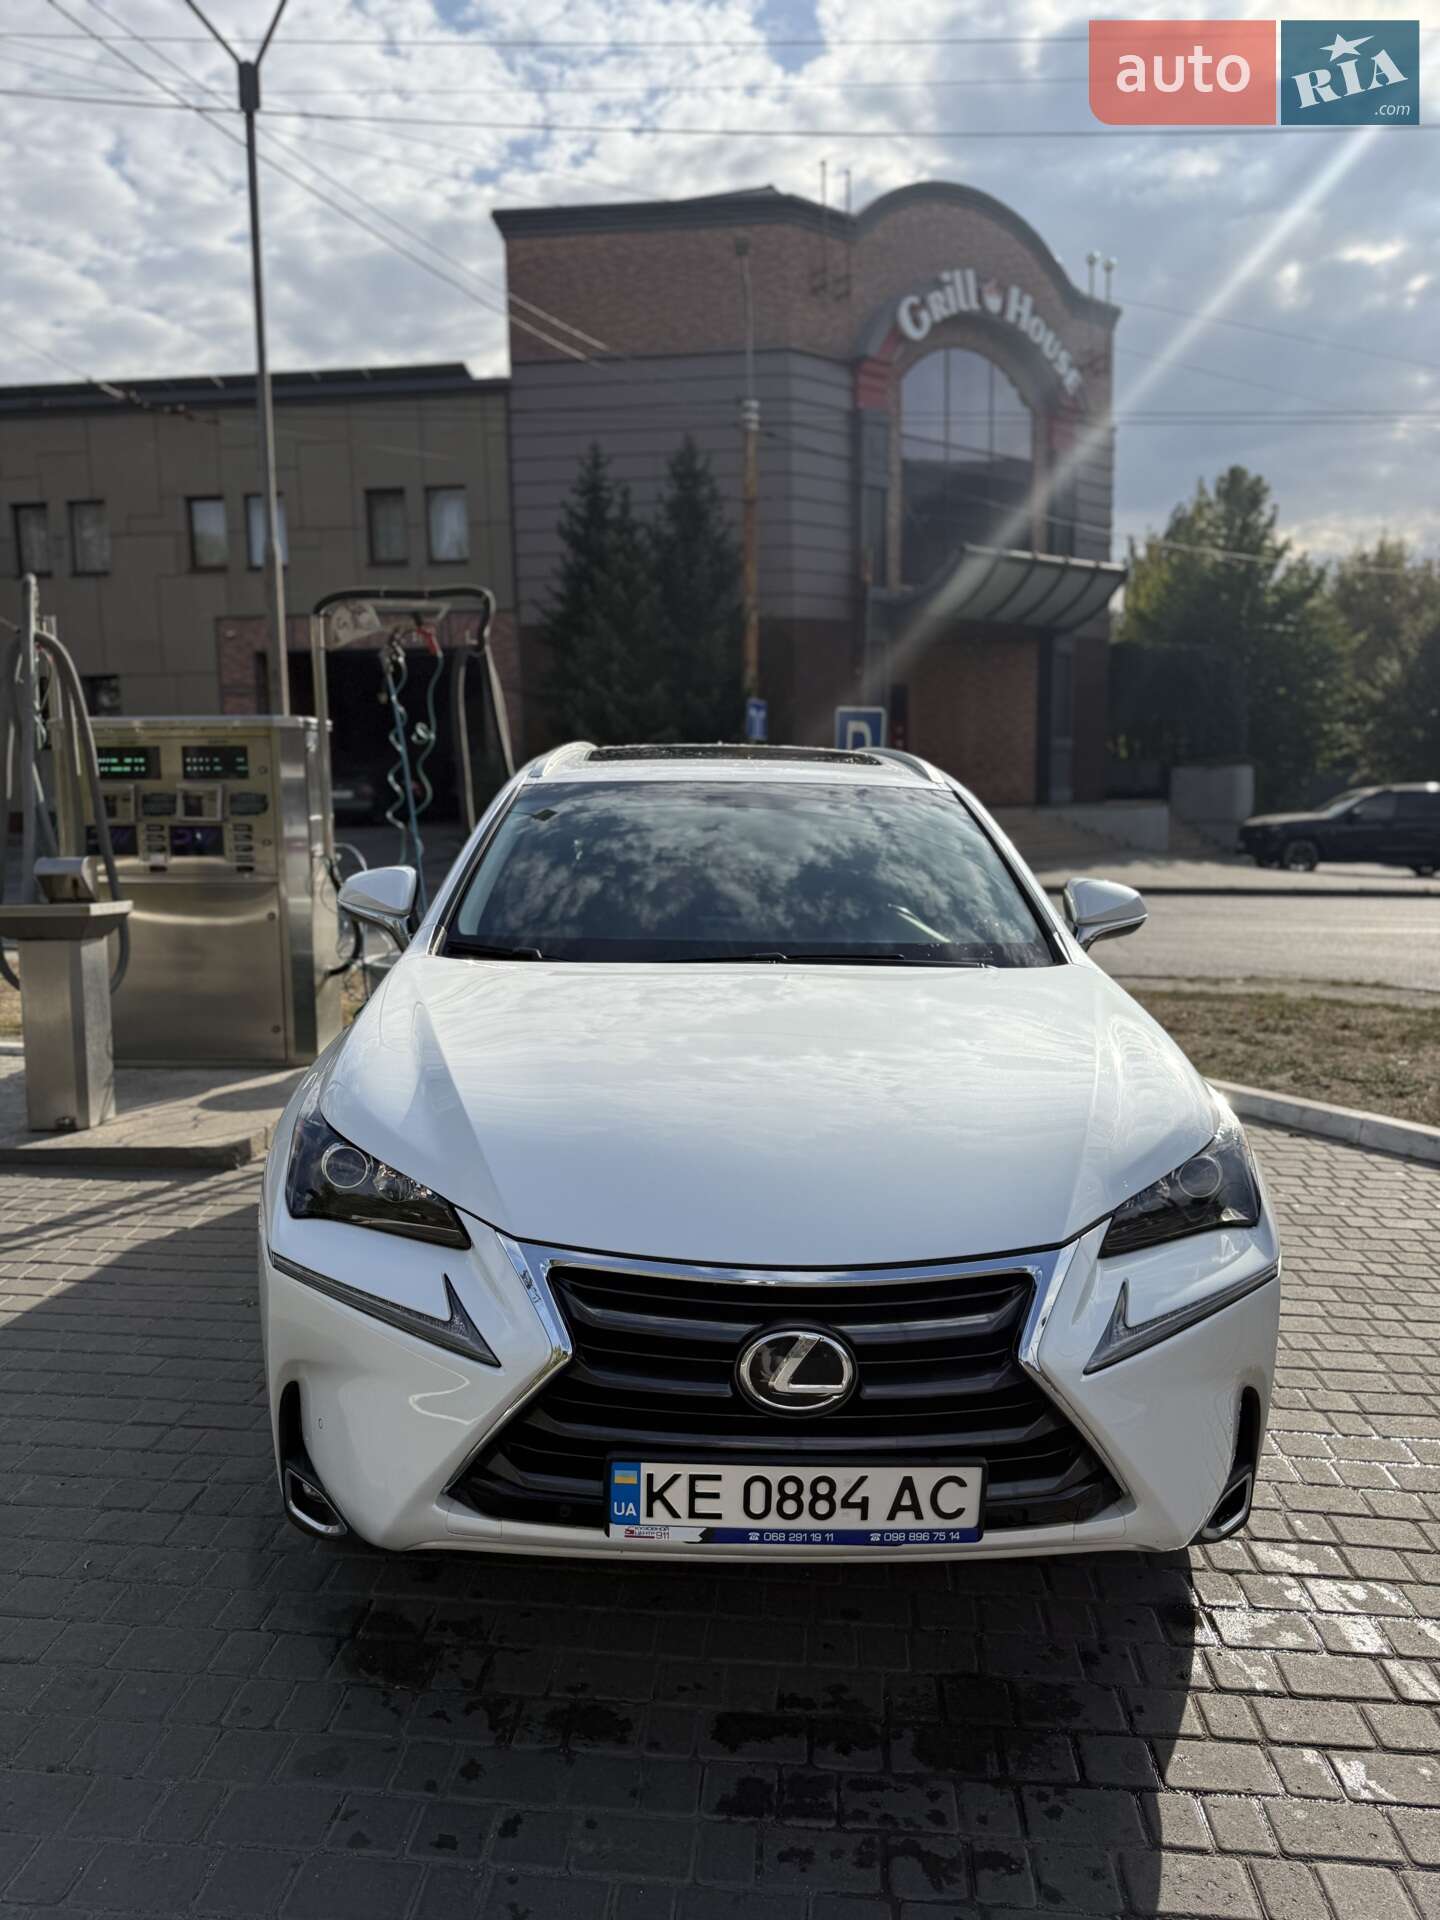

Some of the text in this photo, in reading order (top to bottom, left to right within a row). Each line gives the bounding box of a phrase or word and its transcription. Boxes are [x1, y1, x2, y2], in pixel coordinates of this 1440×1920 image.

[897, 268, 1082, 395] Grill House
[645, 1473, 968, 1521] KE 0884 AC
[613, 1502, 637, 1517] UA
[763, 1532, 834, 1542] 068 291 19 11
[884, 1531, 960, 1541] 098 896 75 14
